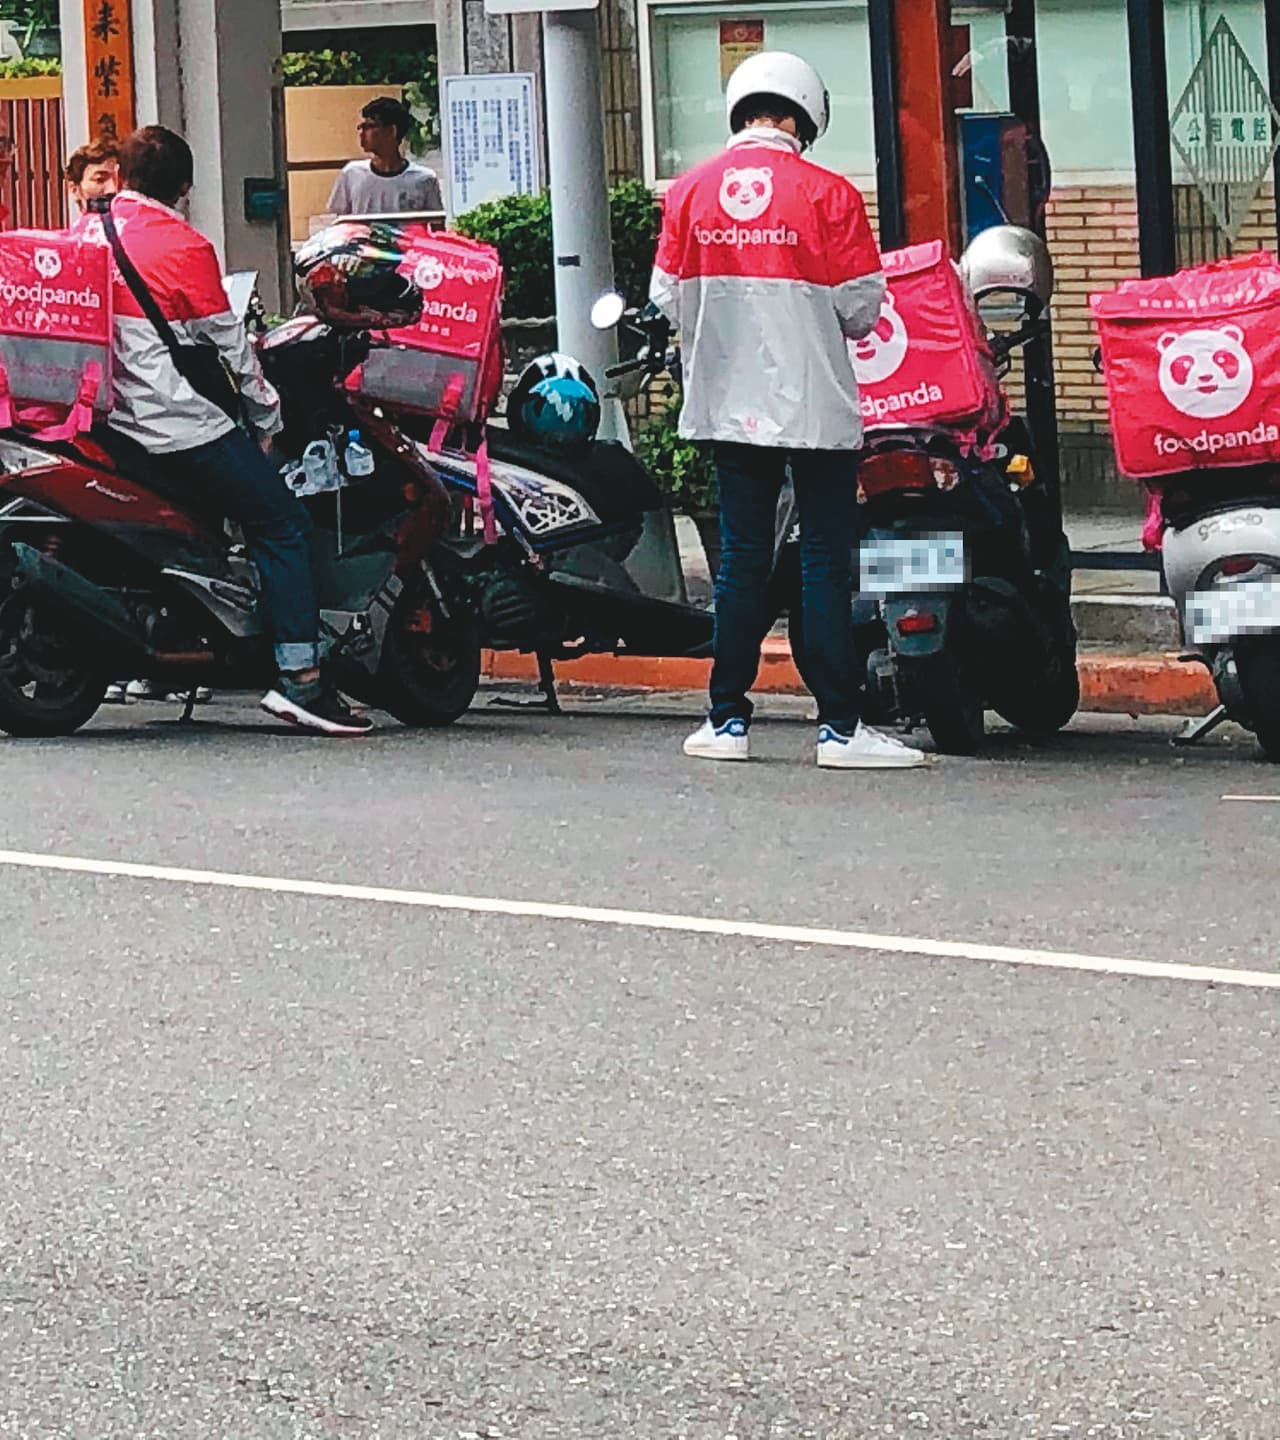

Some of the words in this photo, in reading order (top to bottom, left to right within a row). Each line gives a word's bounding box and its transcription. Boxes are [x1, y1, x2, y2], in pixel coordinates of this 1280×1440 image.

[1186, 117, 1267, 143] 公用電話
[694, 223, 798, 251] foodpanda
[859, 381, 944, 420] dpanda
[1153, 421, 1280, 456] foodpanda
